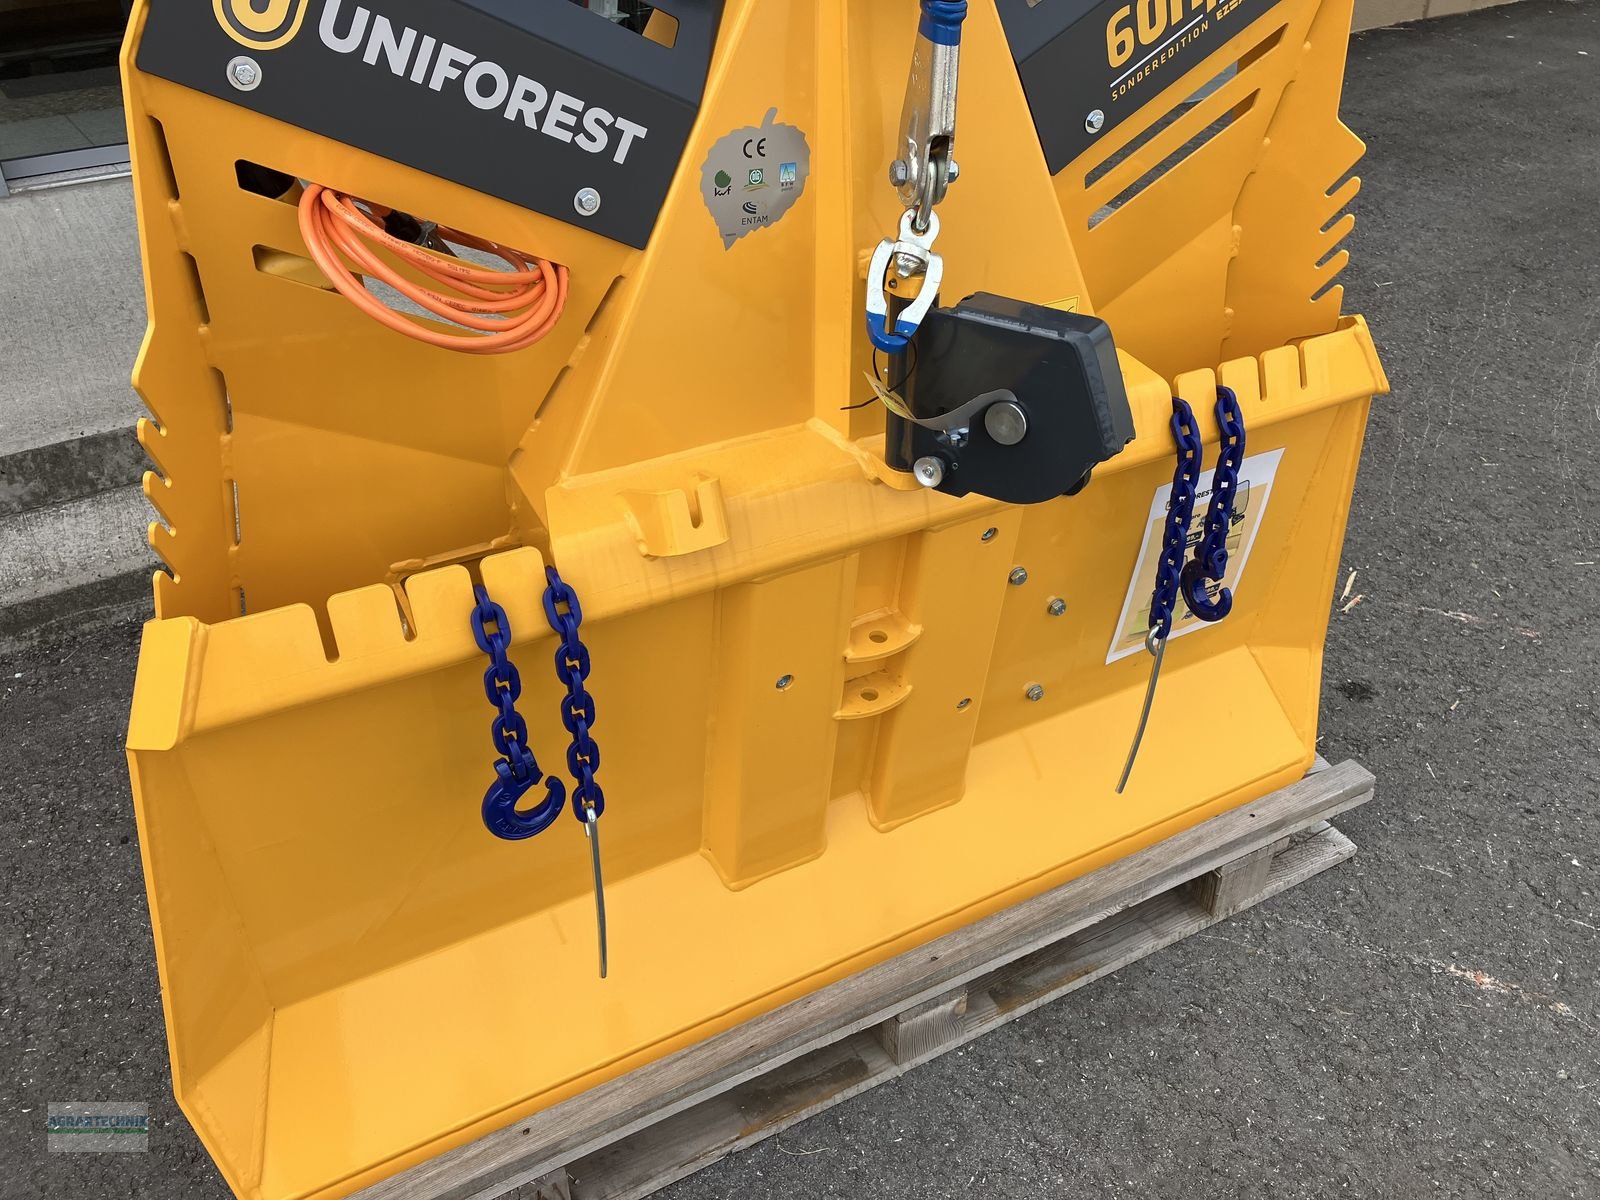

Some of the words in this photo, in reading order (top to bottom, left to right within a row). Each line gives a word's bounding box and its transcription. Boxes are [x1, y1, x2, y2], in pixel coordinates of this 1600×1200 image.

[318, 0, 648, 164] UNIFOREST
[1112, 20, 1209, 101] SONDEREDITION
[743, 138, 766, 158] CE
[741, 215, 769, 225] ENTAM
